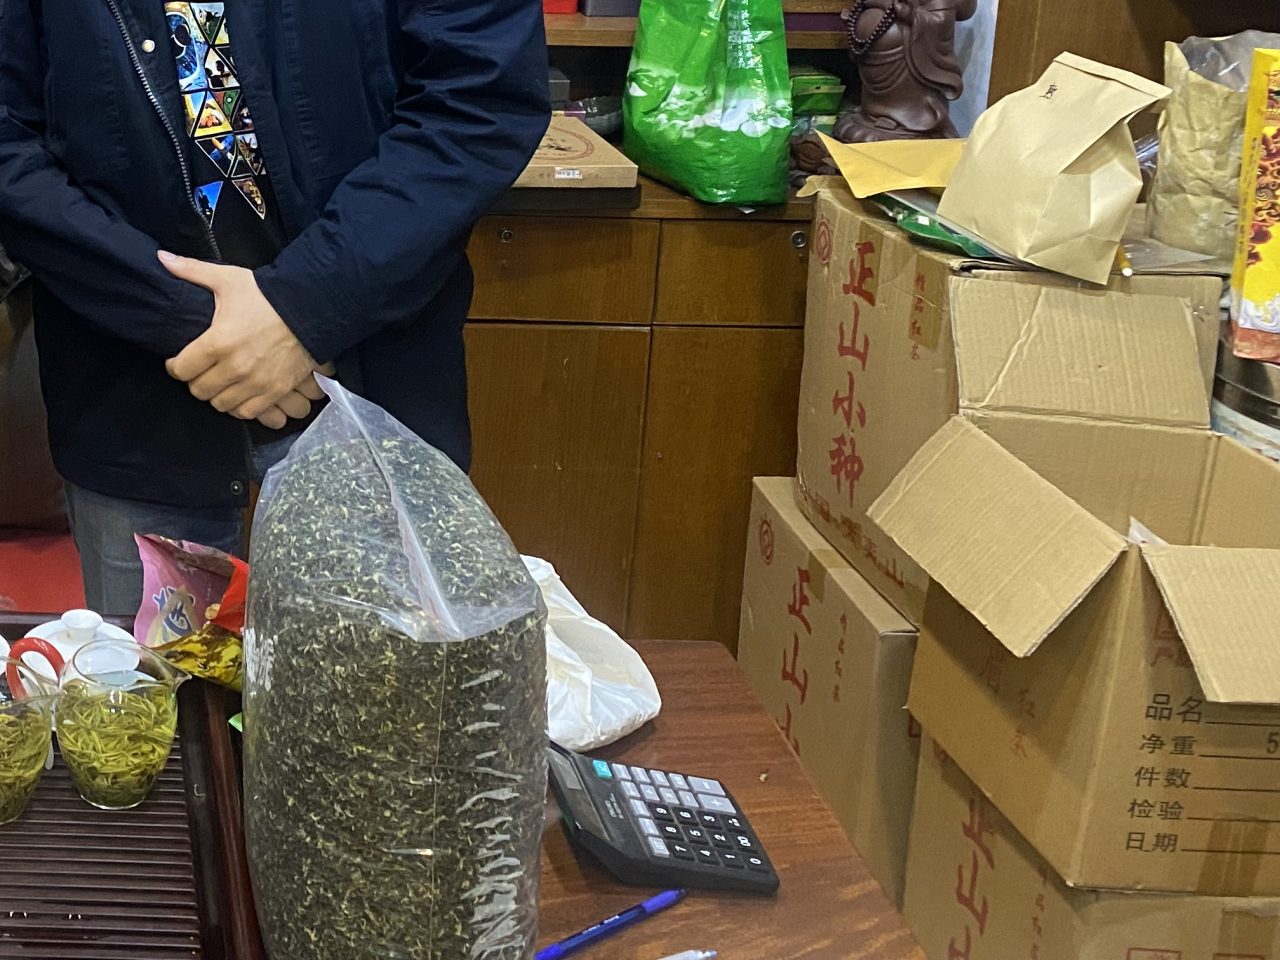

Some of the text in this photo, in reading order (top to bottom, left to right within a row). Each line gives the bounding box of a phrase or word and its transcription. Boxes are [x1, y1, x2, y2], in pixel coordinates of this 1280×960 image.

[908, 271, 926, 362] 精品红茶
[828, 240, 877, 508] 正山小种
[1144, 693, 1204, 724] 品名
[1139, 733, 1198, 757] 净重
[1133, 765, 1192, 789] 件数
[1127, 798, 1185, 821] 检验
[737, 835, 751, 848] 00
[1125, 831, 1179, 853] 日期
